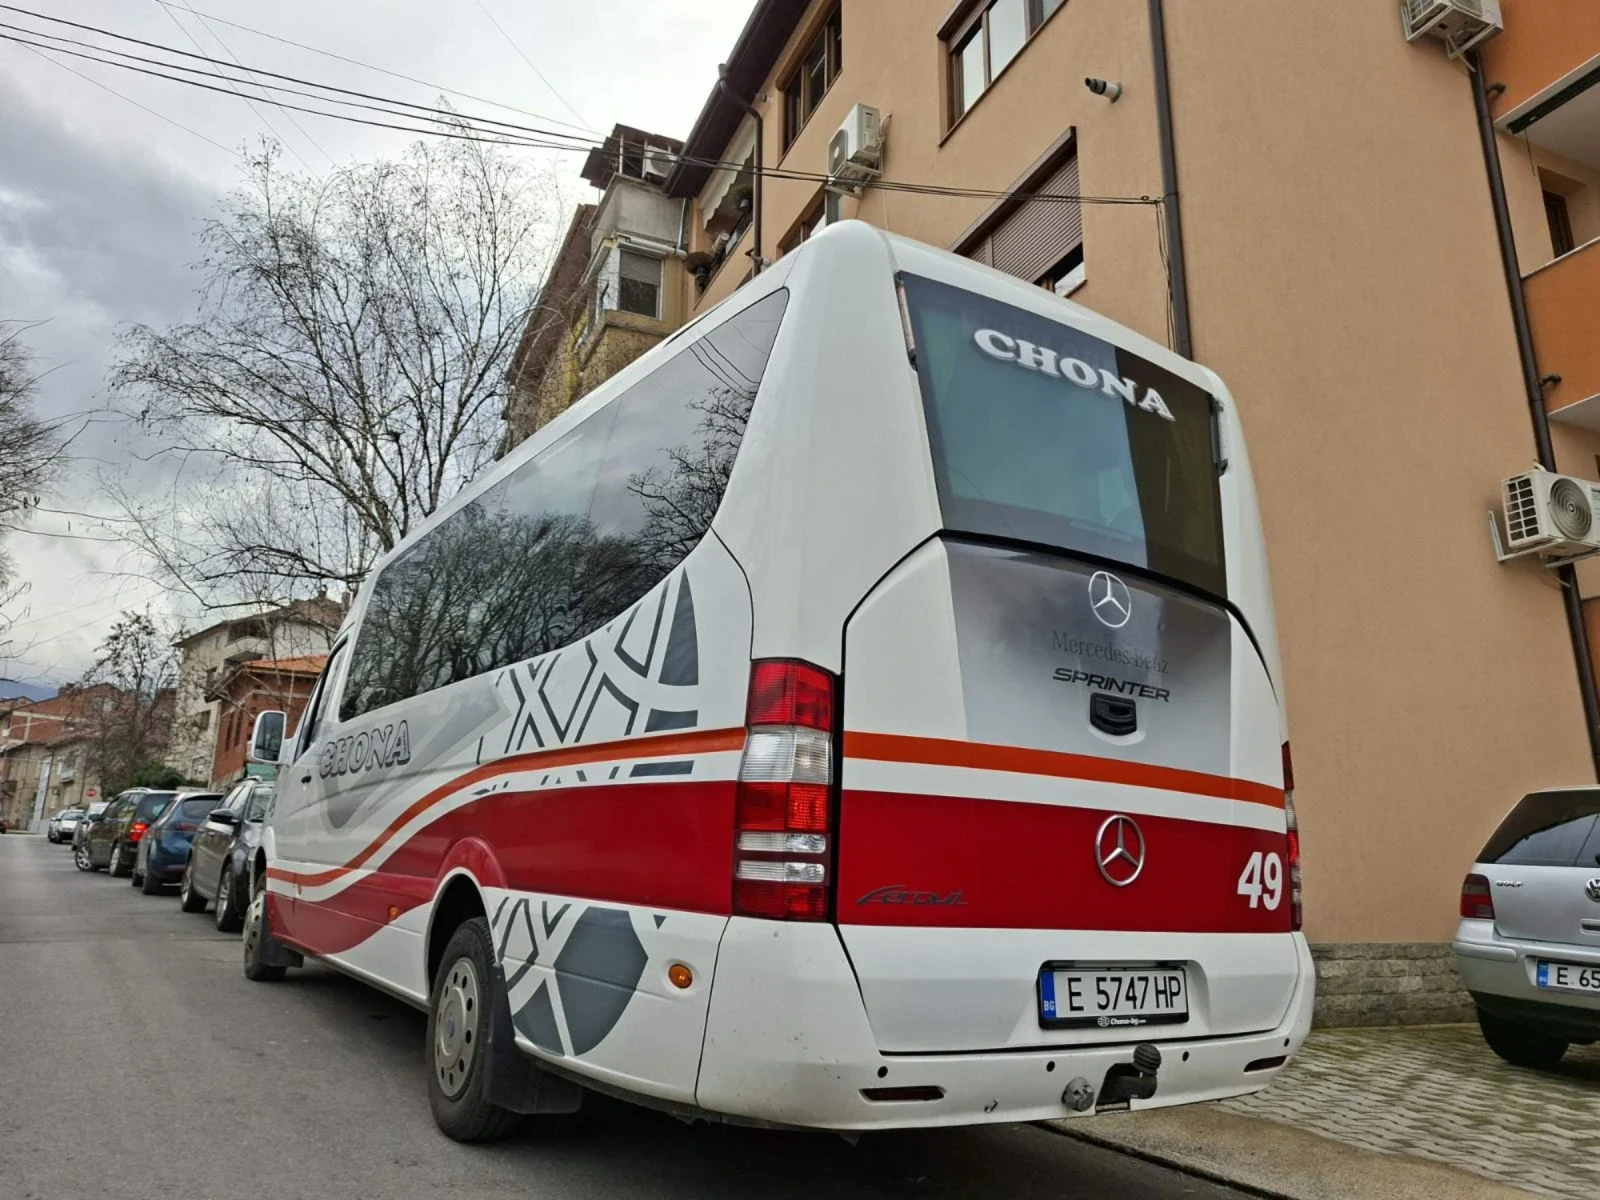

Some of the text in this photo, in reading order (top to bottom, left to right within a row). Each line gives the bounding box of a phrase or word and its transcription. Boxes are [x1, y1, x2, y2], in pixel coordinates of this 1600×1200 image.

[974, 328, 1176, 421] CHONA
[1052, 667, 1170, 702] SPRINTER
[319, 719, 411, 779] CHONA
[1237, 851, 1283, 911] 49
[1067, 975, 1181, 1011] E 5747 HP
[1556, 966, 1569, 986] E
[1043, 1000, 1055, 1012] BG
